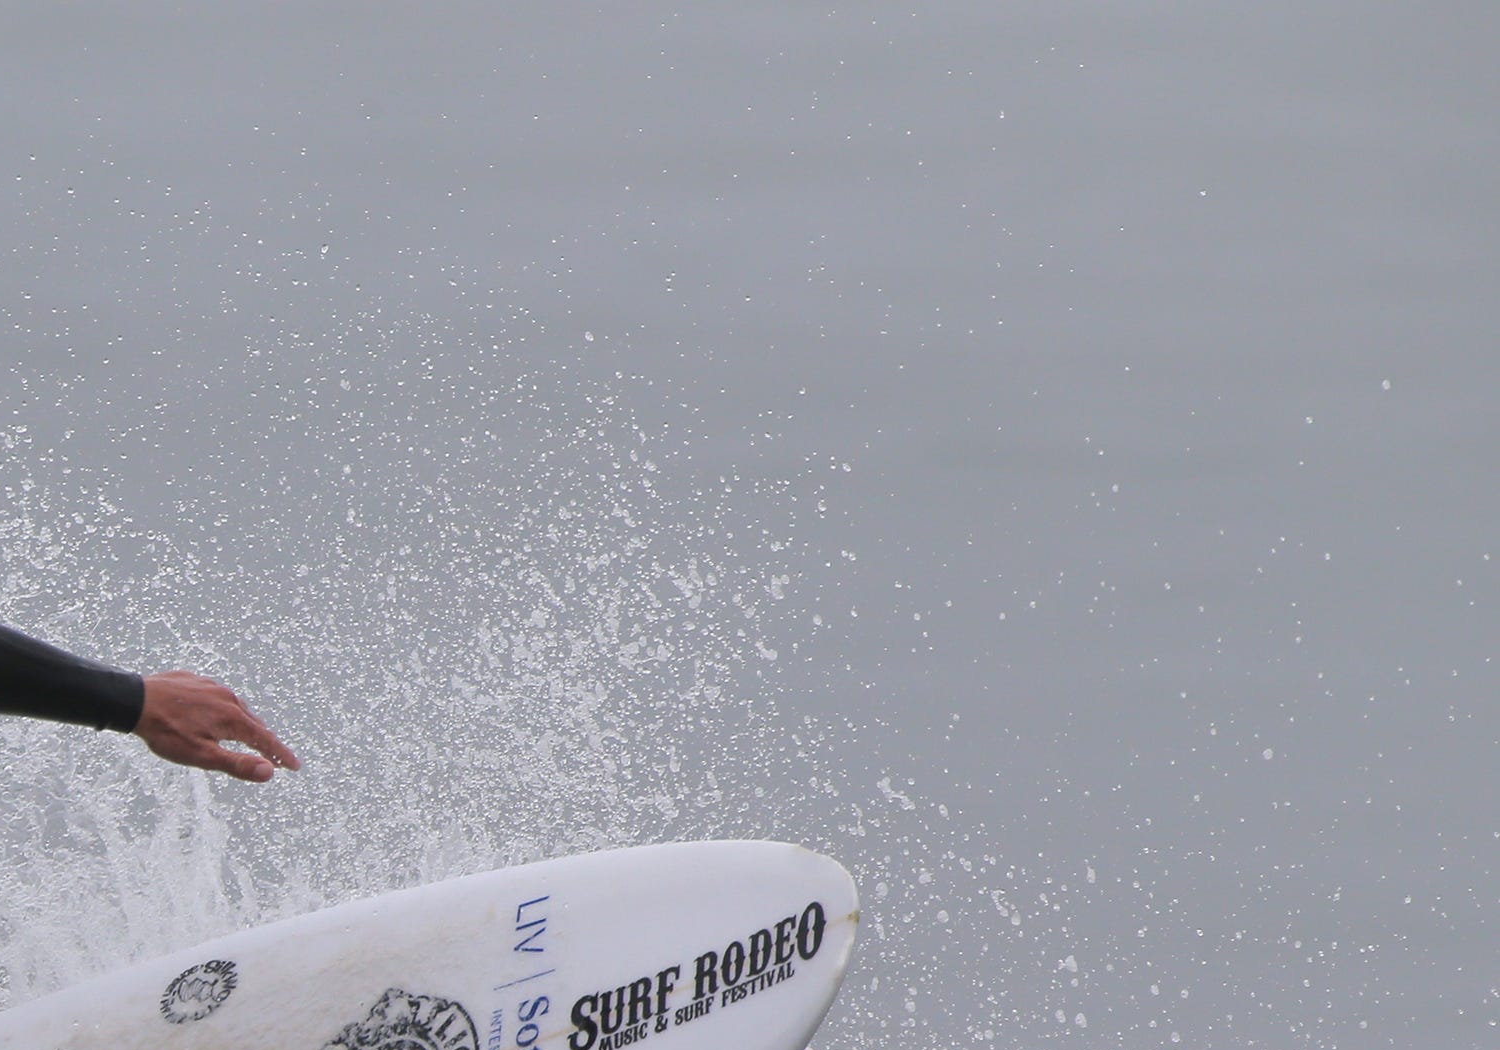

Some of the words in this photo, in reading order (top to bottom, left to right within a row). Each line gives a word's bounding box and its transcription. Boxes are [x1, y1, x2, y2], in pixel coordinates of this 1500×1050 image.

[514, 895, 549, 951] LIV
[692, 901, 827, 1000] RODEO
[654, 1014, 669, 1034] &
[674, 996, 714, 1027] SURF
[721, 962, 796, 1008] FESTIVAL
